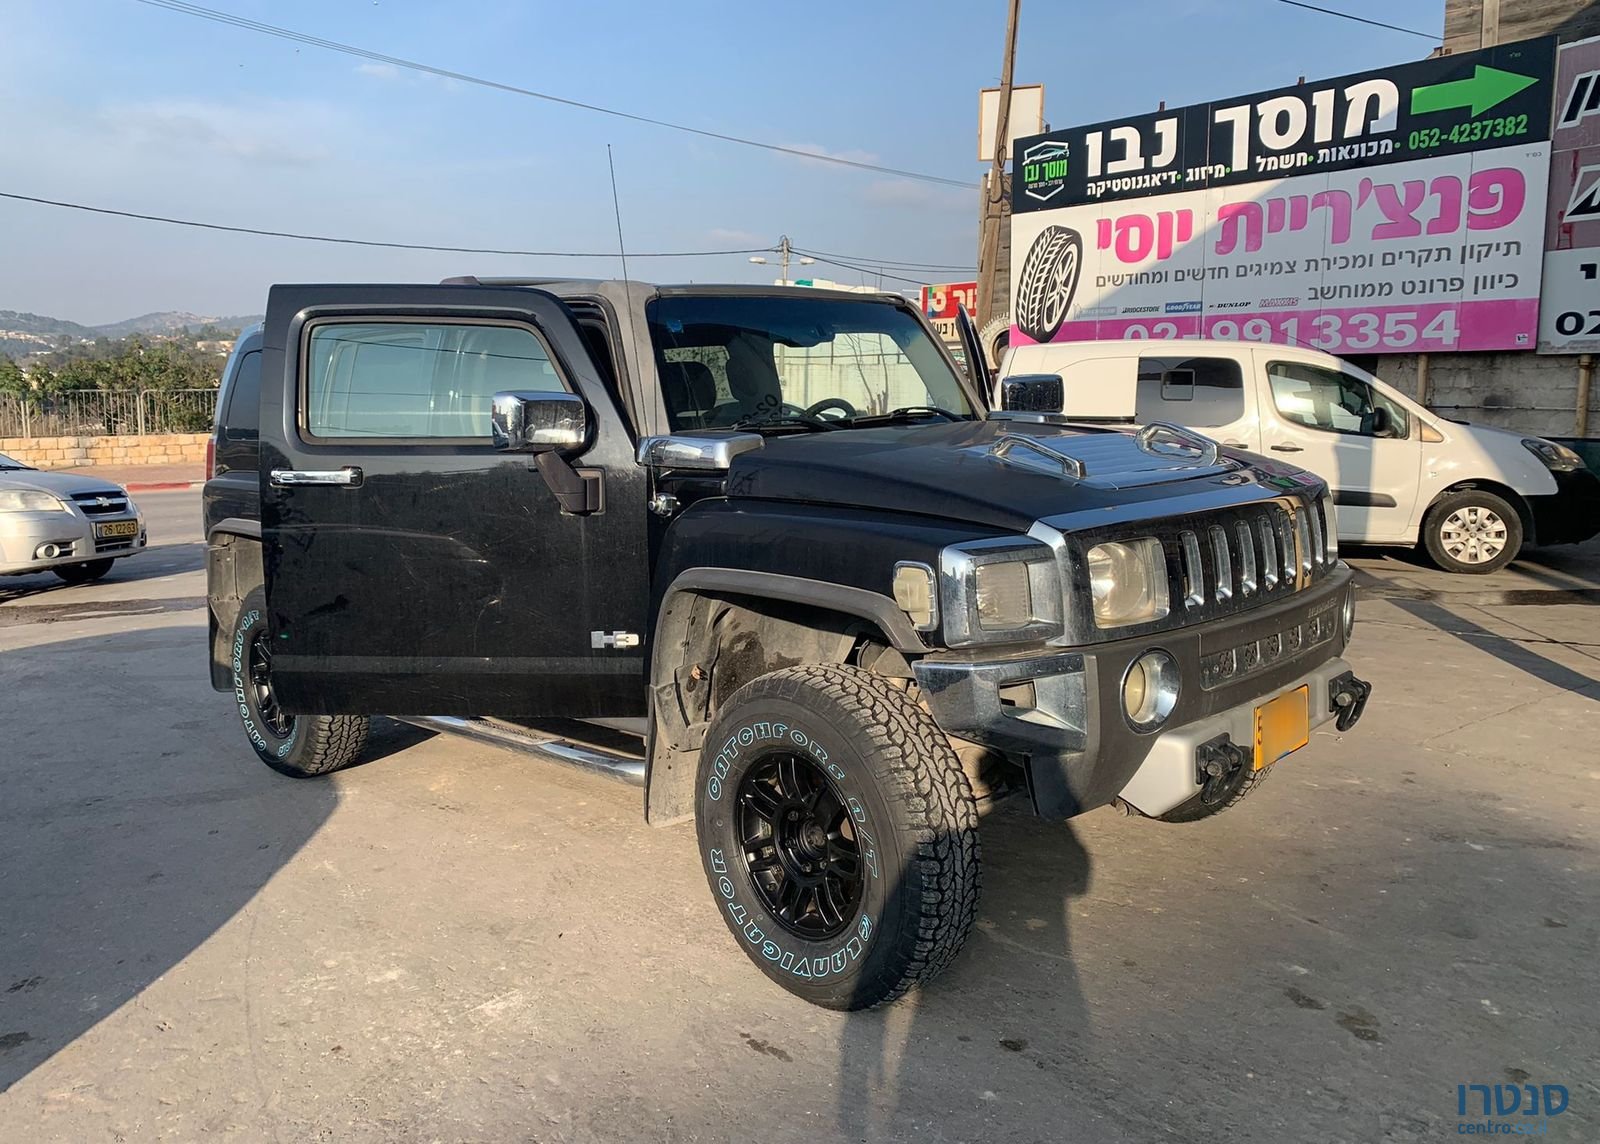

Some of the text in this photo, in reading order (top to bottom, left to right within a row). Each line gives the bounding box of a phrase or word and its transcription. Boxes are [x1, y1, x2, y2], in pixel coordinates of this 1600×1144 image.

[1085, 79, 1400, 178] מוסך נבו
[1408, 114, 1529, 150] 052-4237382
[1024, 159, 1068, 182] מוסך נבו
[1255, 151, 1309, 173] חשמל
[1316, 142, 1393, 164] מכונאות
[1214, 167, 1527, 256] פנצ'ריית
[1095, 209, 1194, 264] יוסי
[1095, 240, 1522, 288] תיקון תקרים ומכירת צמיגים חדשים ומחודשים
[1307, 272, 1519, 301] כיוון פרונט ממוחשב
[1166, 303, 1201, 312] GOODYEAR
[1216, 301, 1251, 309] DUNLOP
[708, 722, 878, 878] CATCHFORS A/T
[710, 849, 862, 977] LANVIGATOR
